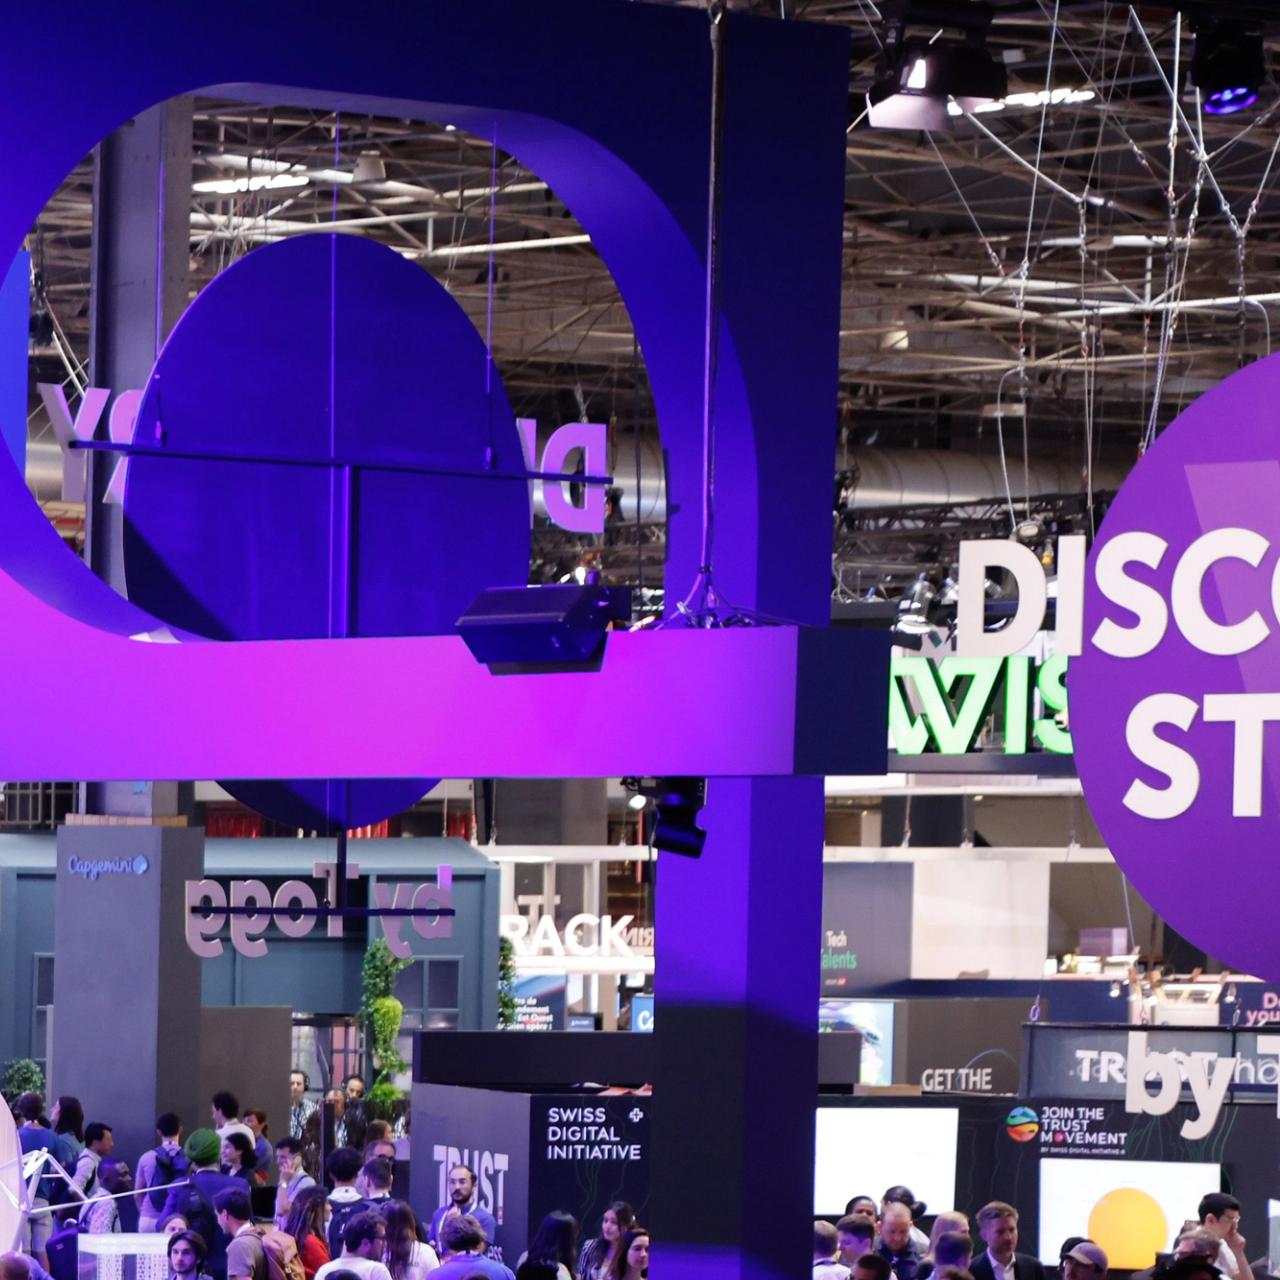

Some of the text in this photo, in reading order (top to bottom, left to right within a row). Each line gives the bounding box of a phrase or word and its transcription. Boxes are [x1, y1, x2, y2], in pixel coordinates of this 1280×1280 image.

[957, 528, 1280, 658] DISC
[67, 855, 133, 880] Capgemini
[821, 947, 858, 970] alents
[922, 1067, 992, 1091] GET THE
[1125, 1031, 1237, 1140] by
[548, 1107, 606, 1122] SWISS
[1042, 1107, 1104, 1120] JOIN THE
[1042, 1119, 1090, 1131] TRUST
[547, 1126, 621, 1141] DIGITAL
[547, 1145, 642, 1160] INITIATIVE
[433, 1145, 509, 1226] TST
